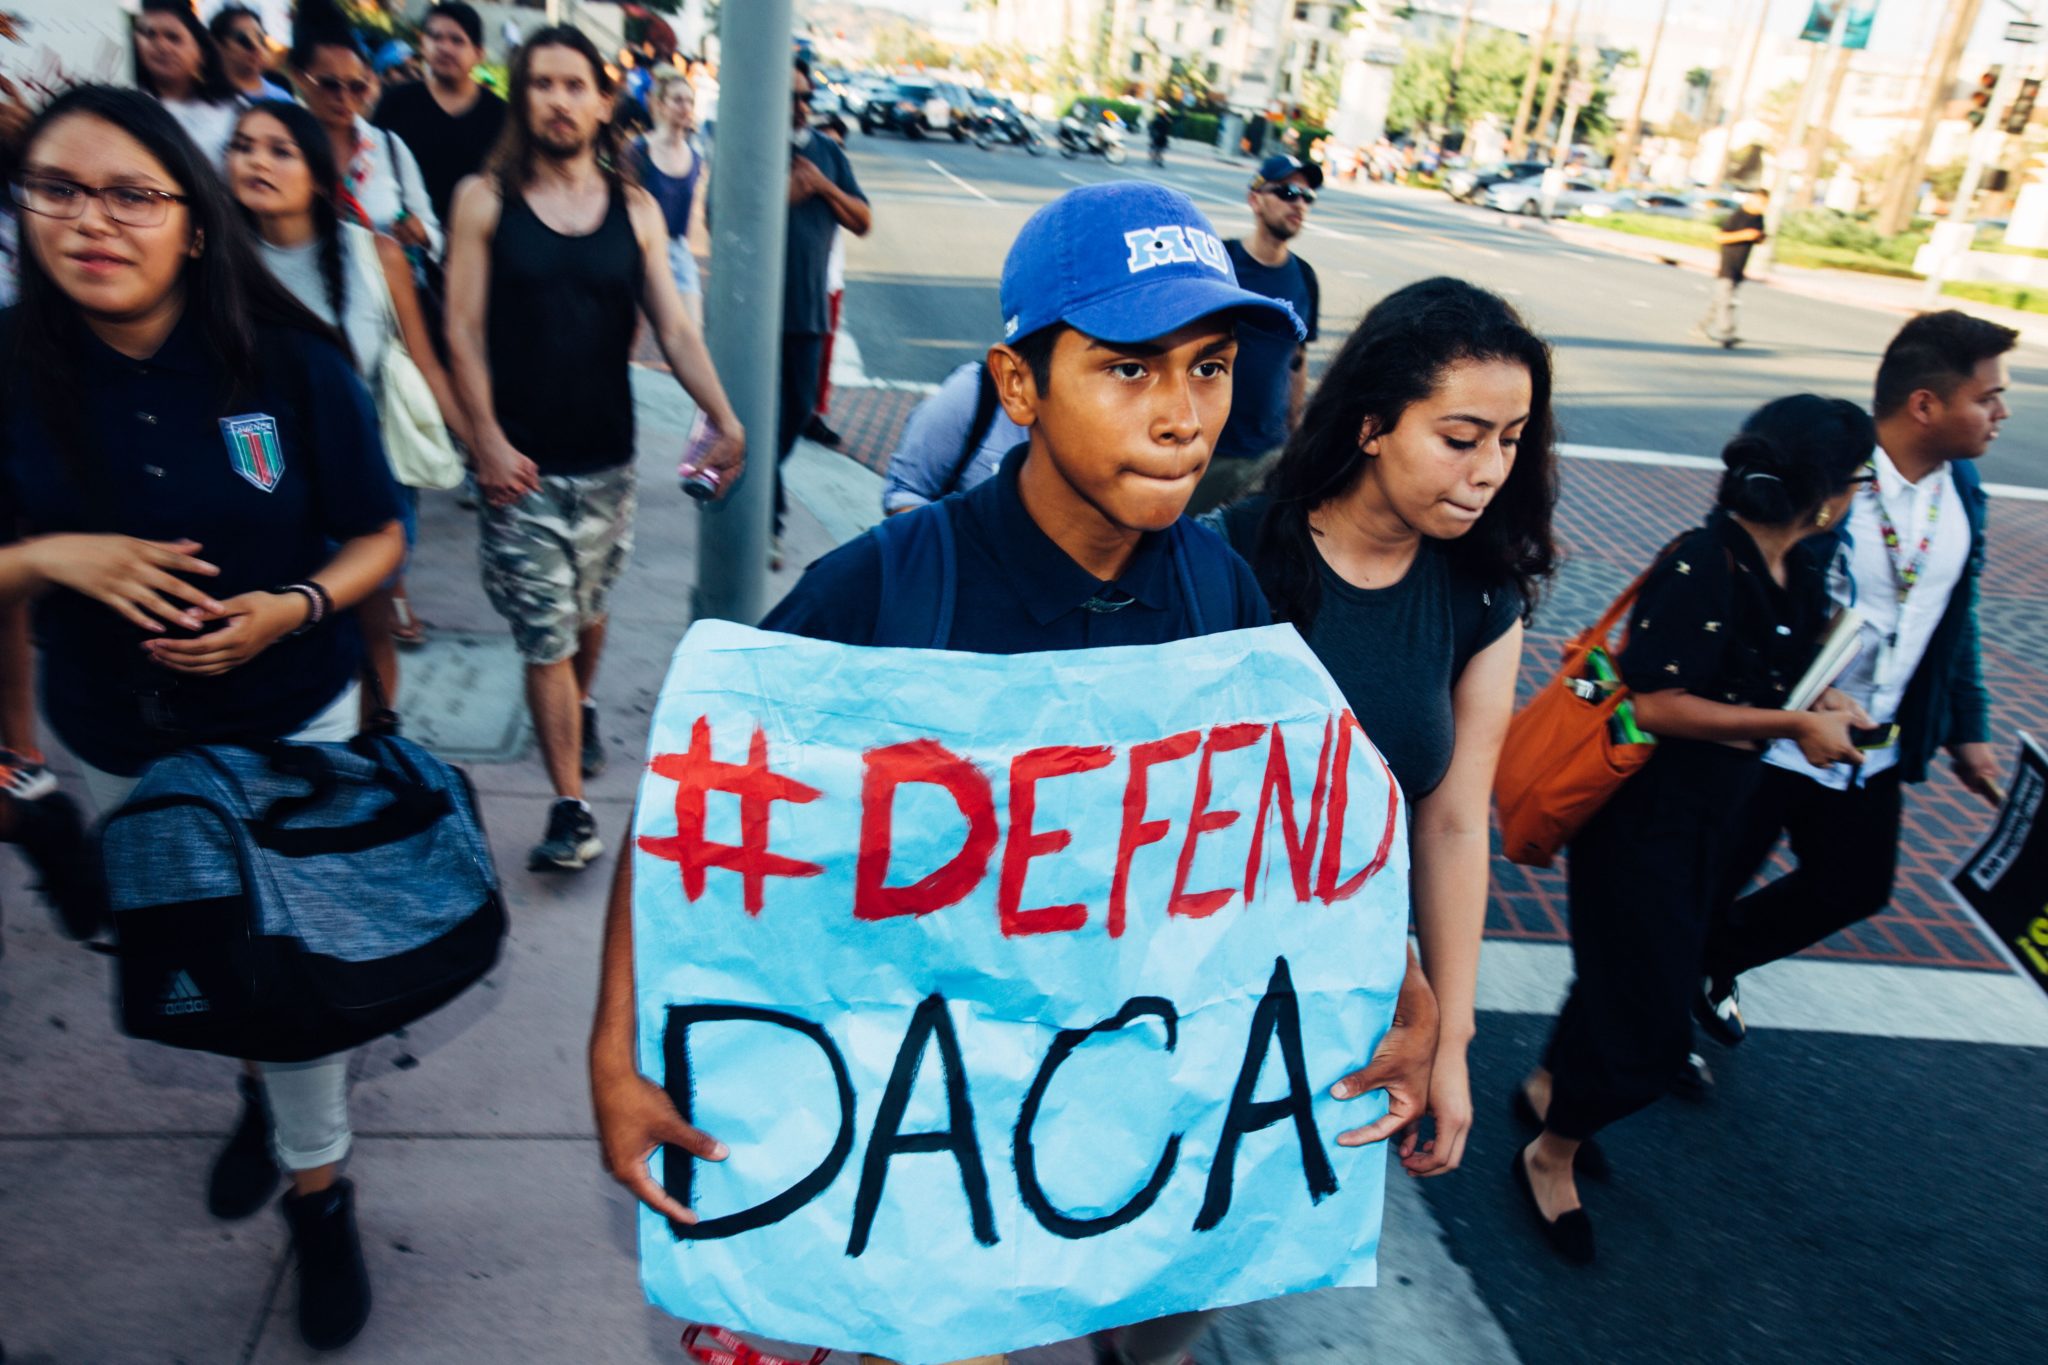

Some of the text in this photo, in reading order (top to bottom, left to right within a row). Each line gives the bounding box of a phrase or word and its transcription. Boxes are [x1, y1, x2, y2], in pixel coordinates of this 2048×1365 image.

[1124, 225, 1229, 274] MU
[637, 708, 1399, 938] #DEFEND
[663, 956, 1340, 1259] DACA
